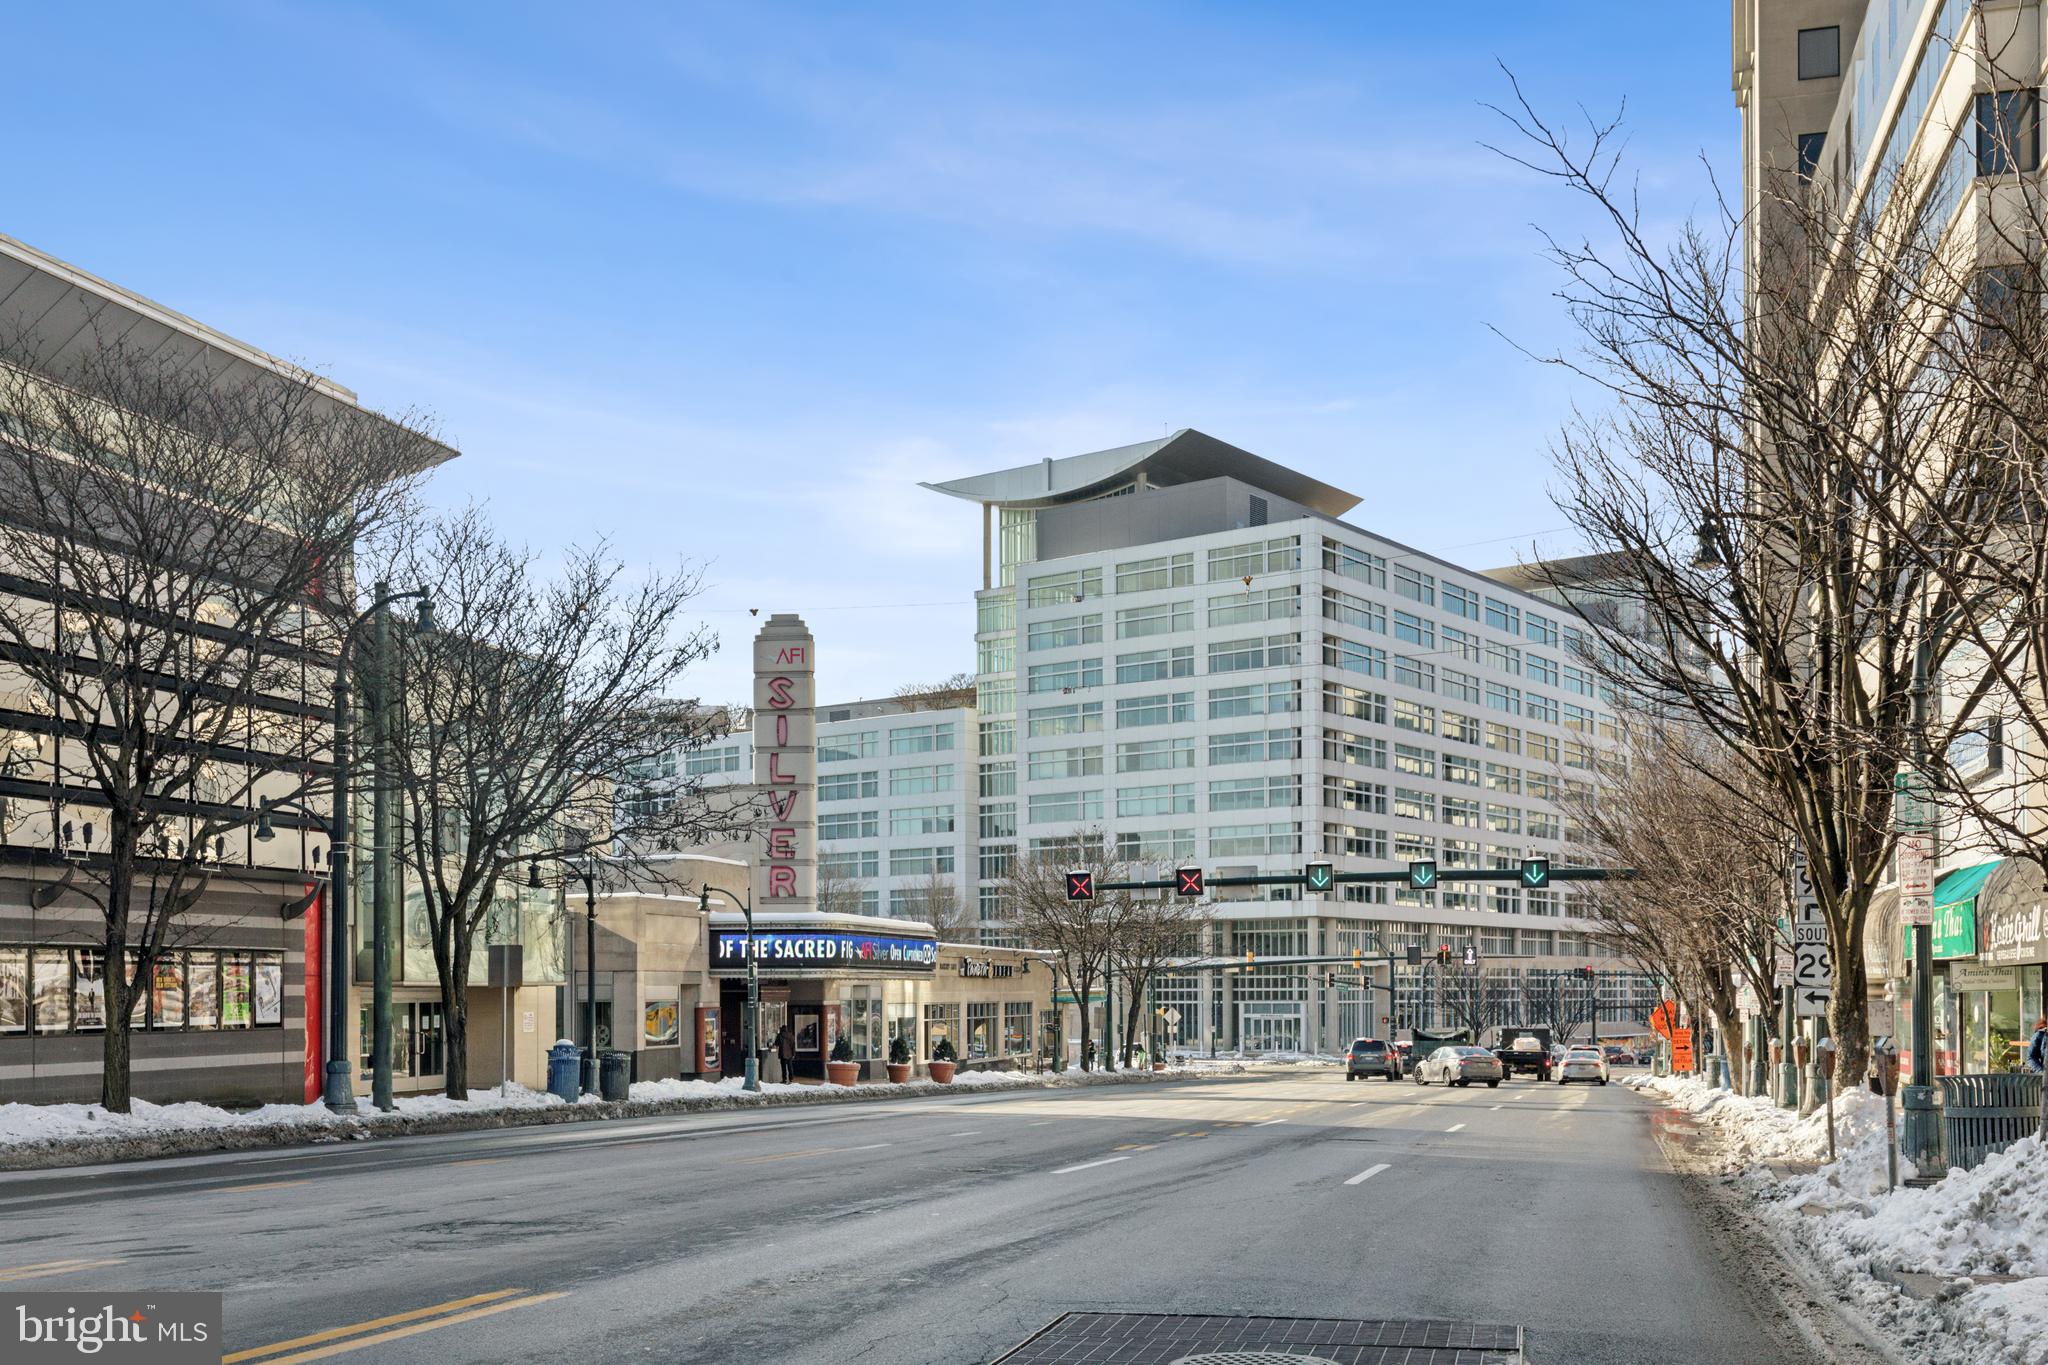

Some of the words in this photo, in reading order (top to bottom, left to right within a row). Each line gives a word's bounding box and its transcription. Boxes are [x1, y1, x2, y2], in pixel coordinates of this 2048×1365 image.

[776, 647, 804, 664] AFI
[767, 676, 797, 898] SILVER
[1944, 904, 1963, 937] Thai
[1798, 928, 1827, 941] SOUT
[2014, 905, 2041, 960] Grill
[740, 941, 768, 958] THE
[775, 940, 836, 958] SACRED
[841, 941, 853, 958] FIG
[1799, 953, 1831, 978] 29
[1956, 968, 1989, 977] Amina
[1990, 967, 2013, 976] Thai
